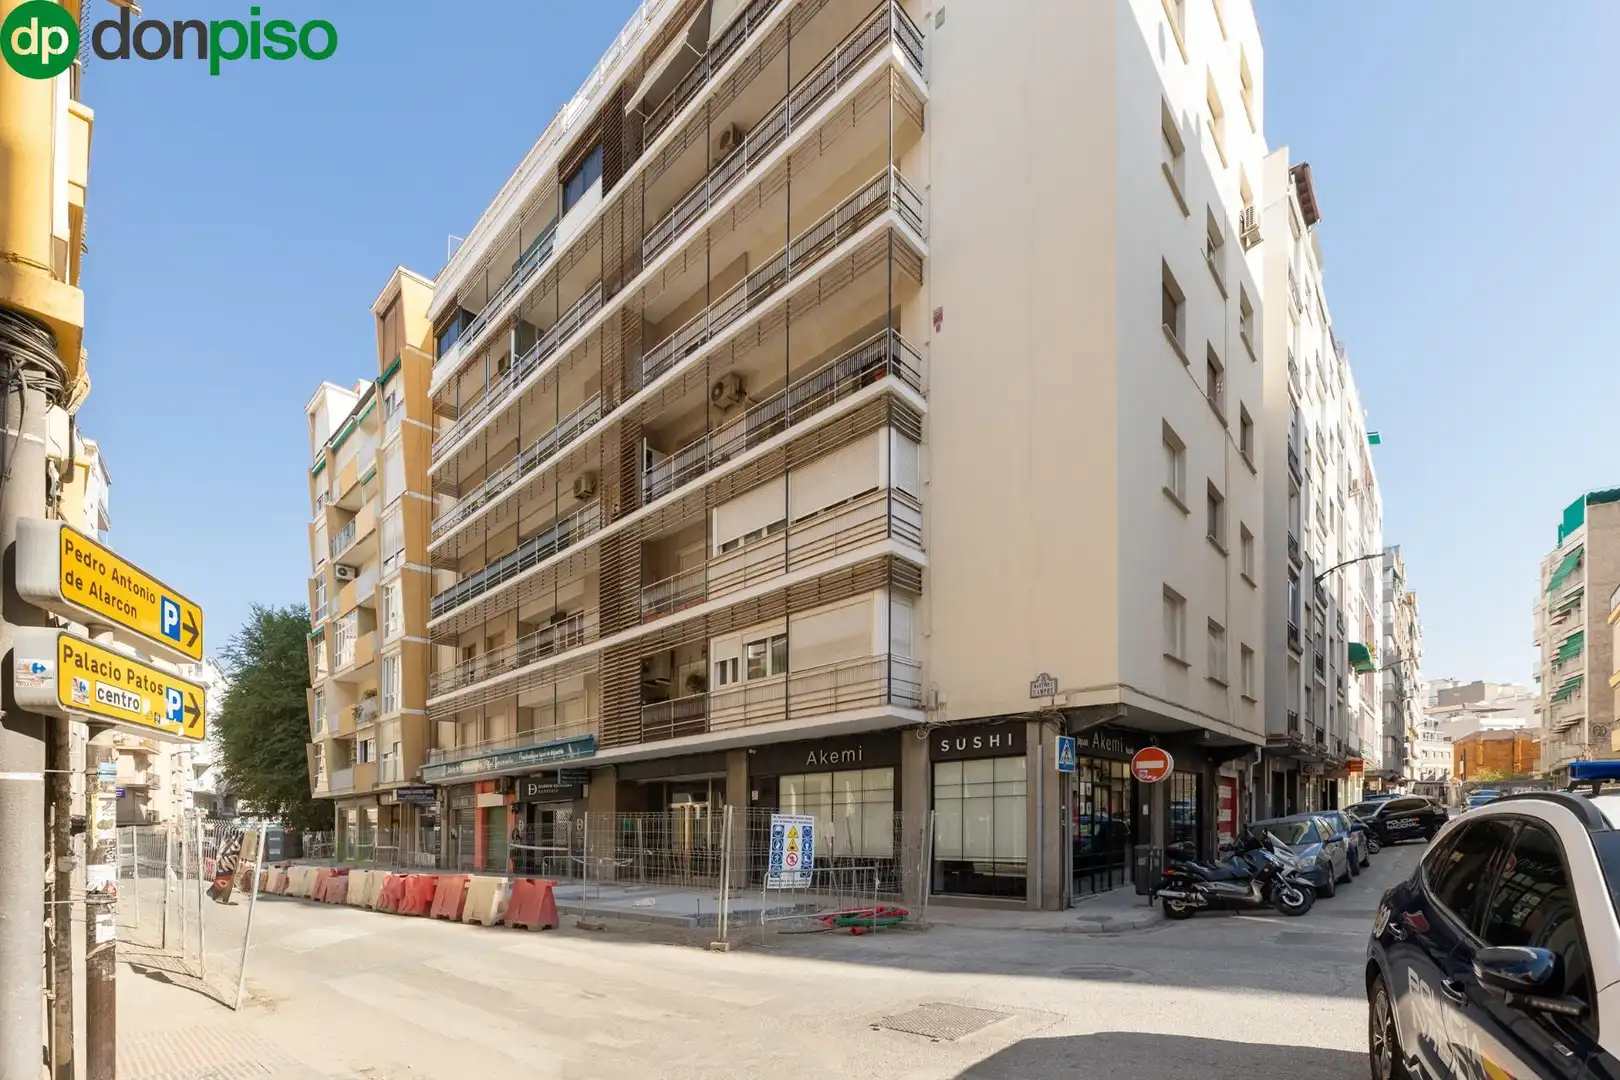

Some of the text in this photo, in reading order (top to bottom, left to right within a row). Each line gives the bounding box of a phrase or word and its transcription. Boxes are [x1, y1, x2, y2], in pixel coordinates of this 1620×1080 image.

[64, 538, 156, 604] Pedro Antonio
[65, 570, 138, 619] de Alarcón
[163, 600, 179, 634] P
[63, 645, 122, 681] Palacio
[126, 668, 164, 696] Patos
[97, 687, 140, 711] centro
[166, 690, 182, 719] P
[806, 745, 862, 765] Akemi
[941, 733, 1012, 752] SUSHI
[1092, 731, 1123, 753] Akemi
